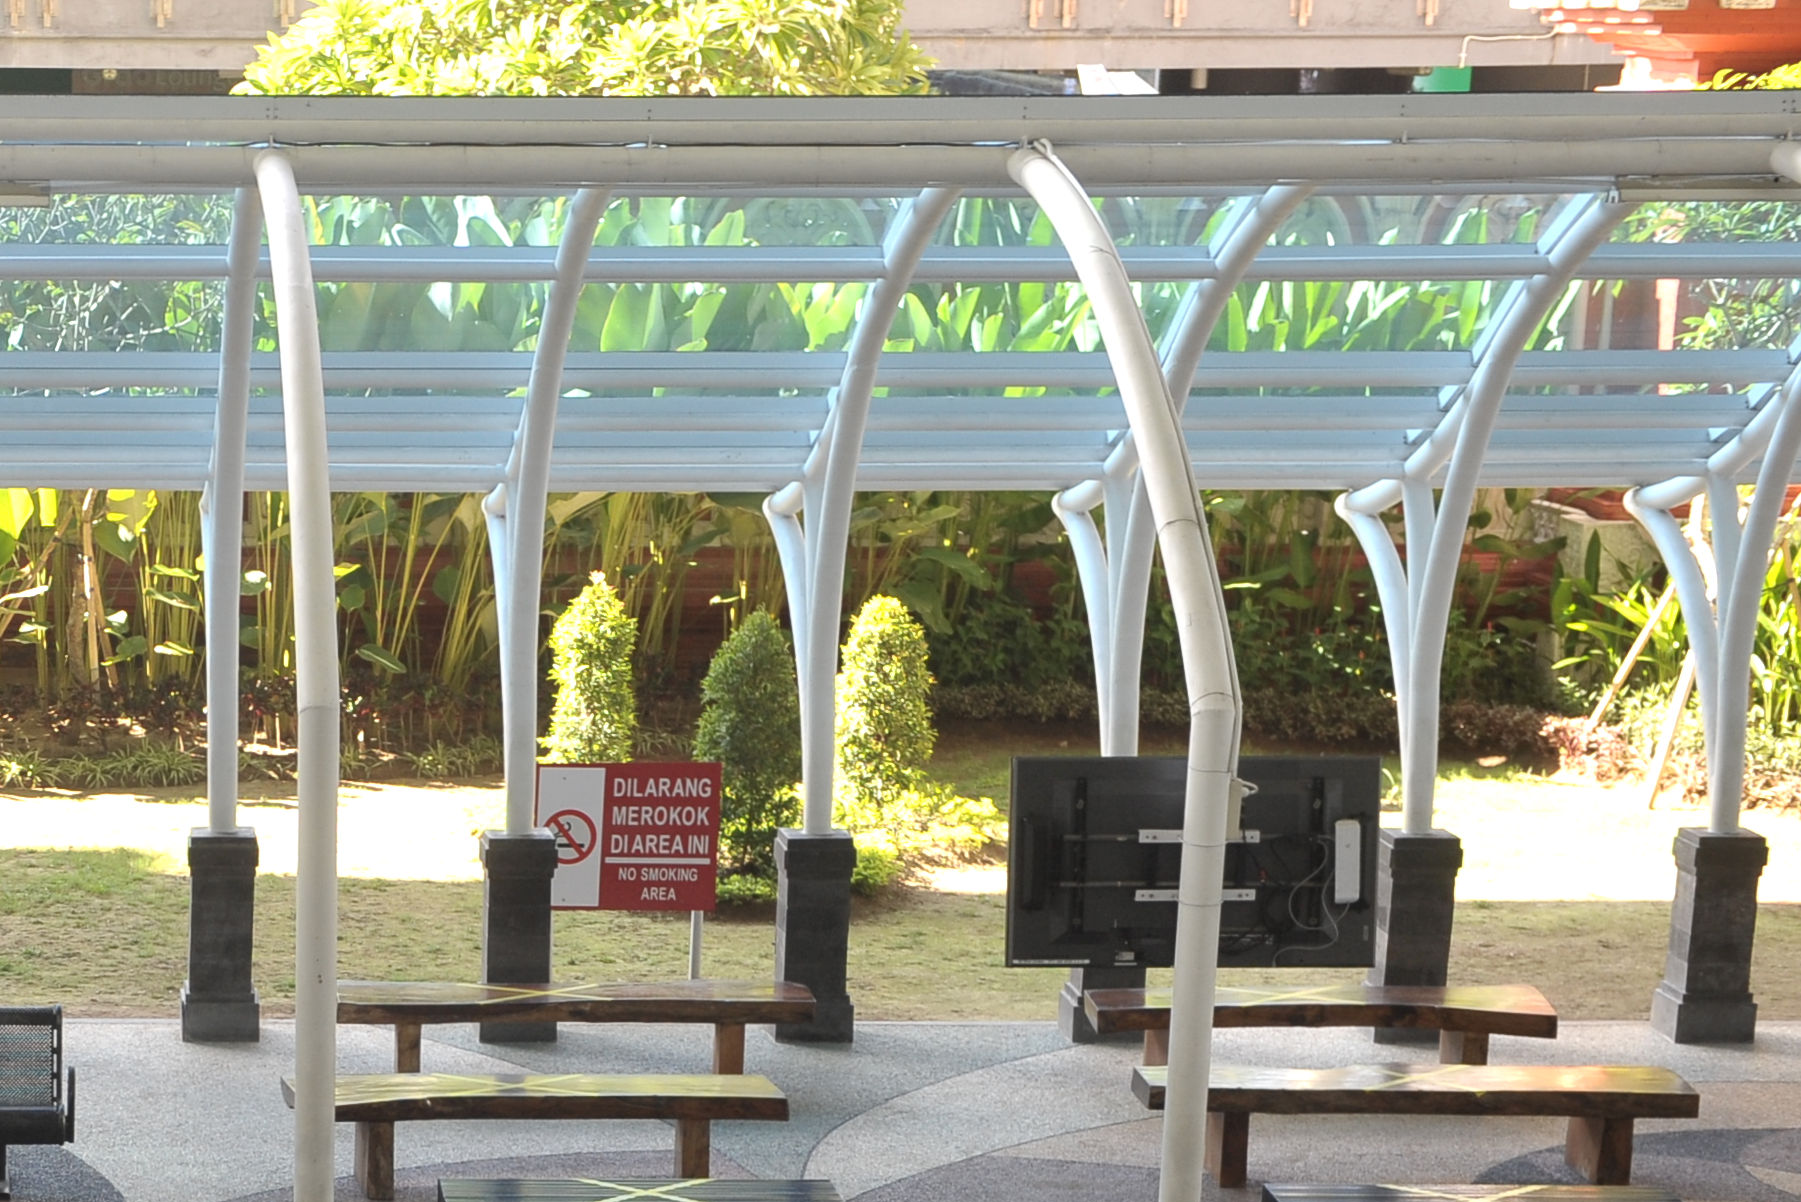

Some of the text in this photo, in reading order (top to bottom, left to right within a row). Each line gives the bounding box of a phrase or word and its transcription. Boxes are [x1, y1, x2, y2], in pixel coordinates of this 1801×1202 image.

[613, 778, 712, 798] DILARANG
[612, 806, 710, 826] MEROKOK
[610, 834, 709, 854] DI AREA INI
[618, 867, 698, 882] NO SMOKING
[641, 887, 676, 901] AREA
